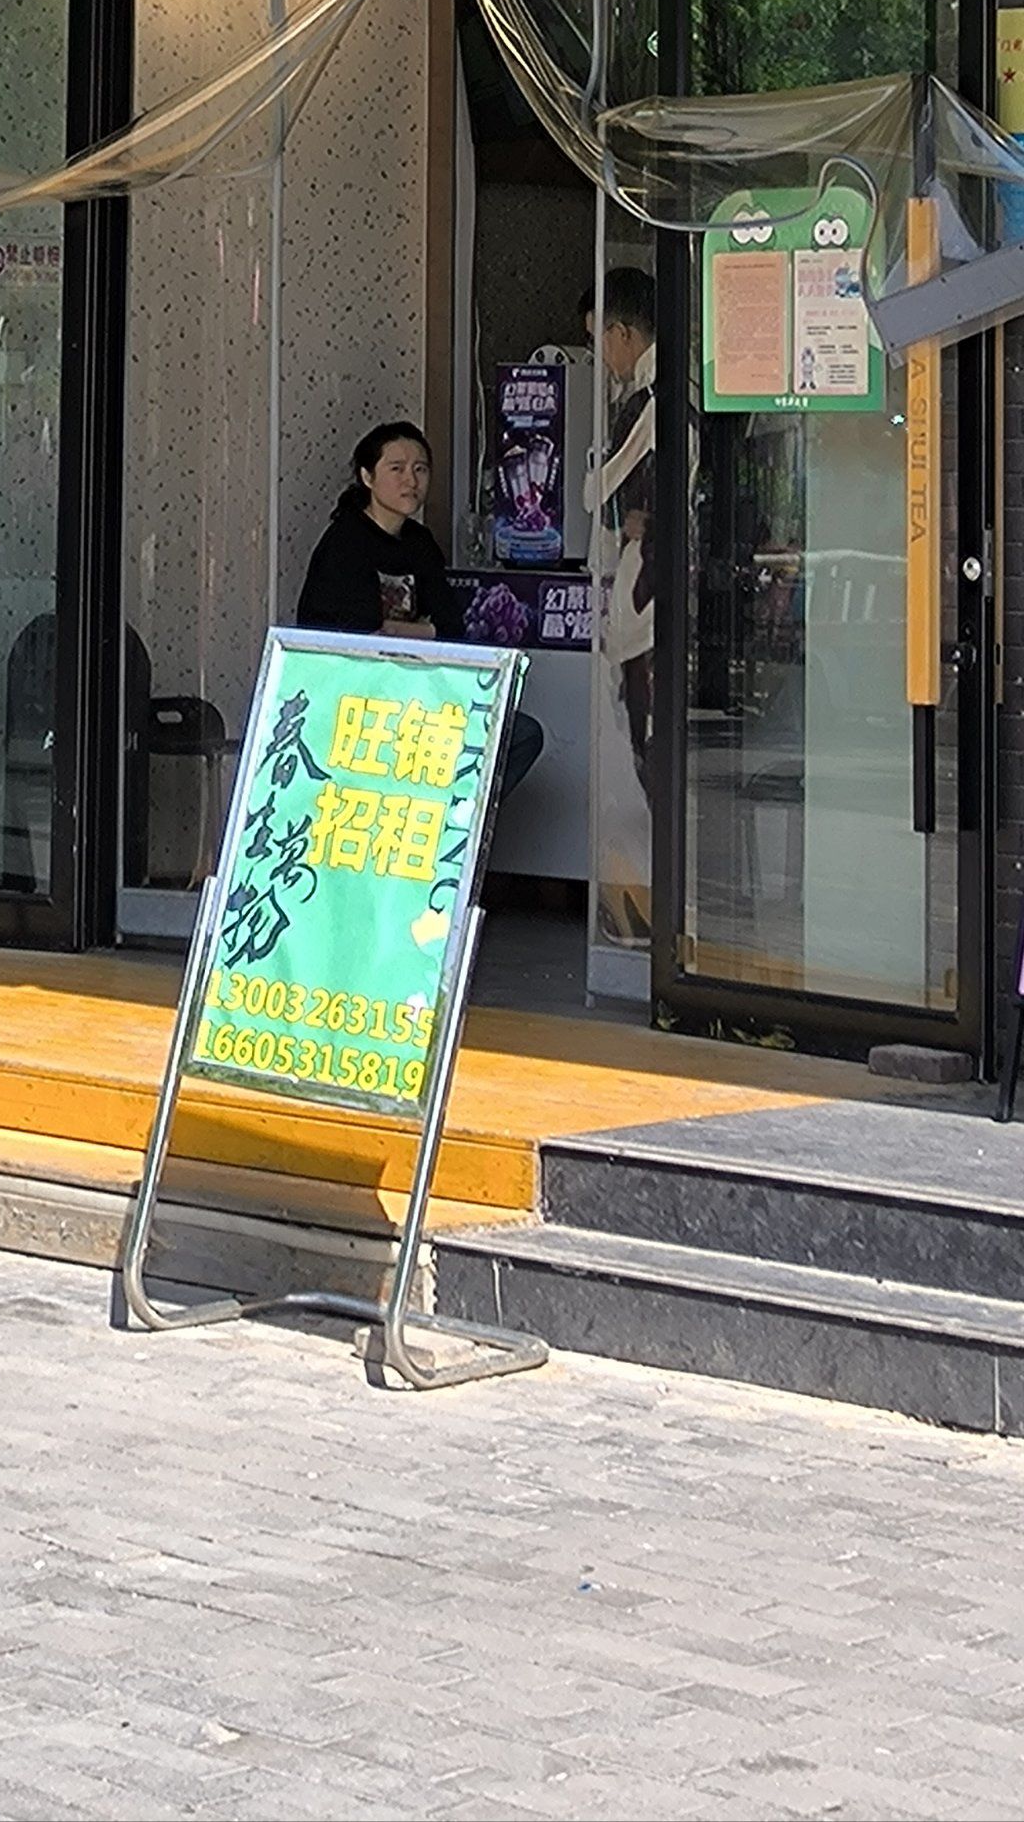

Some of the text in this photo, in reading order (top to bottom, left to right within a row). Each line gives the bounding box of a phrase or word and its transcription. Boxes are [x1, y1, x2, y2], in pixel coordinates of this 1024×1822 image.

[910, 483, 927, 543] TEA
[328, 694, 468, 788] 旺铺
[307, 781, 448, 882] 招租
[204, 969, 436, 1049] 13003263155
[194, 1019, 426, 1100] 16605315819
